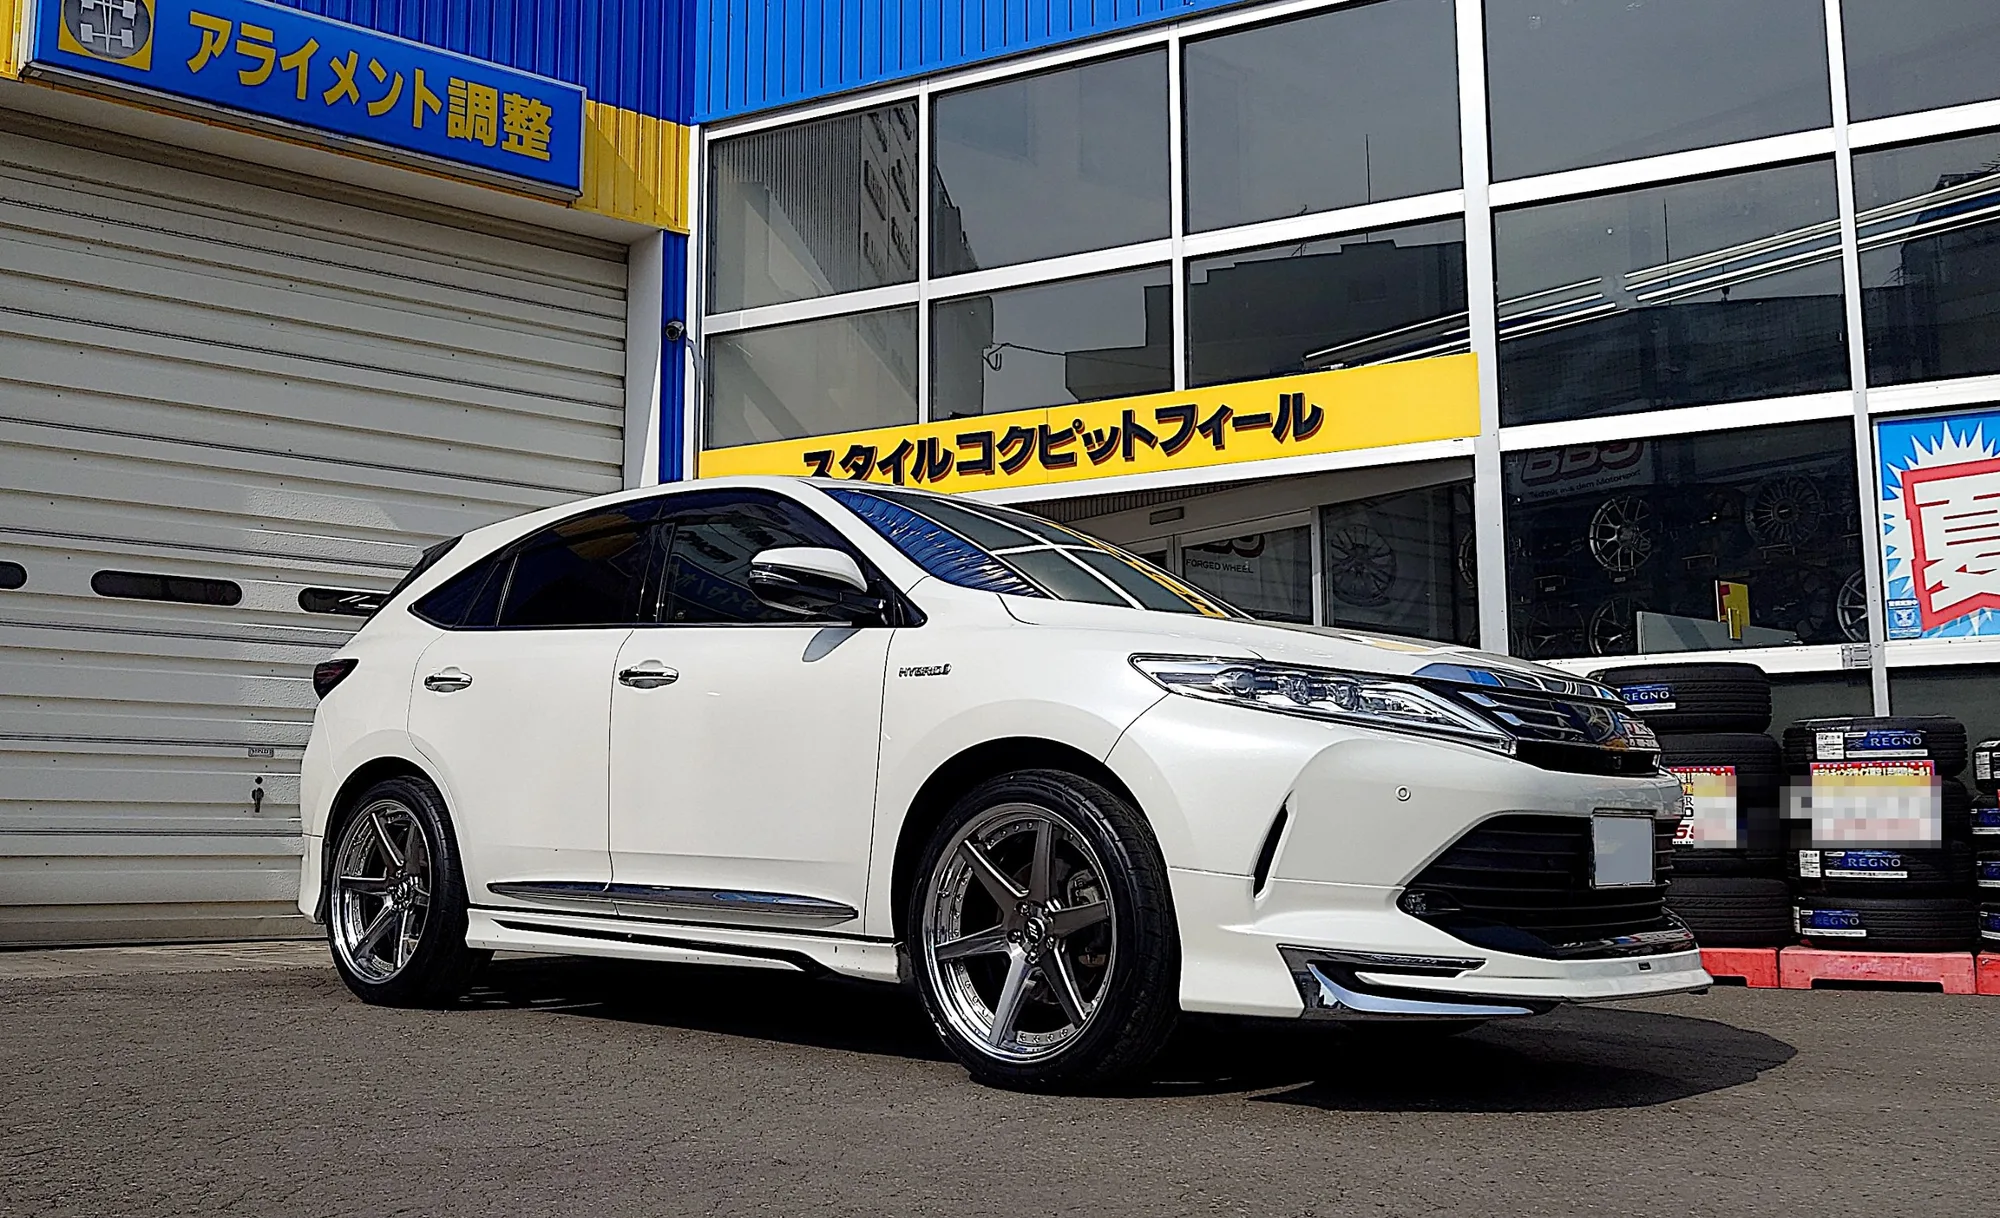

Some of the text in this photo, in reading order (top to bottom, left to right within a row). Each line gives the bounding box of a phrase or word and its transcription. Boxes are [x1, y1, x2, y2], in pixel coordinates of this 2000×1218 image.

[187, 10, 553, 162] アライメント調整
[802, 392, 1325, 485] スタイルコクピットフィール
[1596, 469, 1641, 485] Motorsport
[1186, 558, 1254, 574] FORGED WHEEL
[1623, 690, 1670, 701] REGNO
[1870, 736, 1922, 747] REGNO
[1847, 857, 1901, 867] REGNO
[1814, 916, 1860, 926] REGNO
